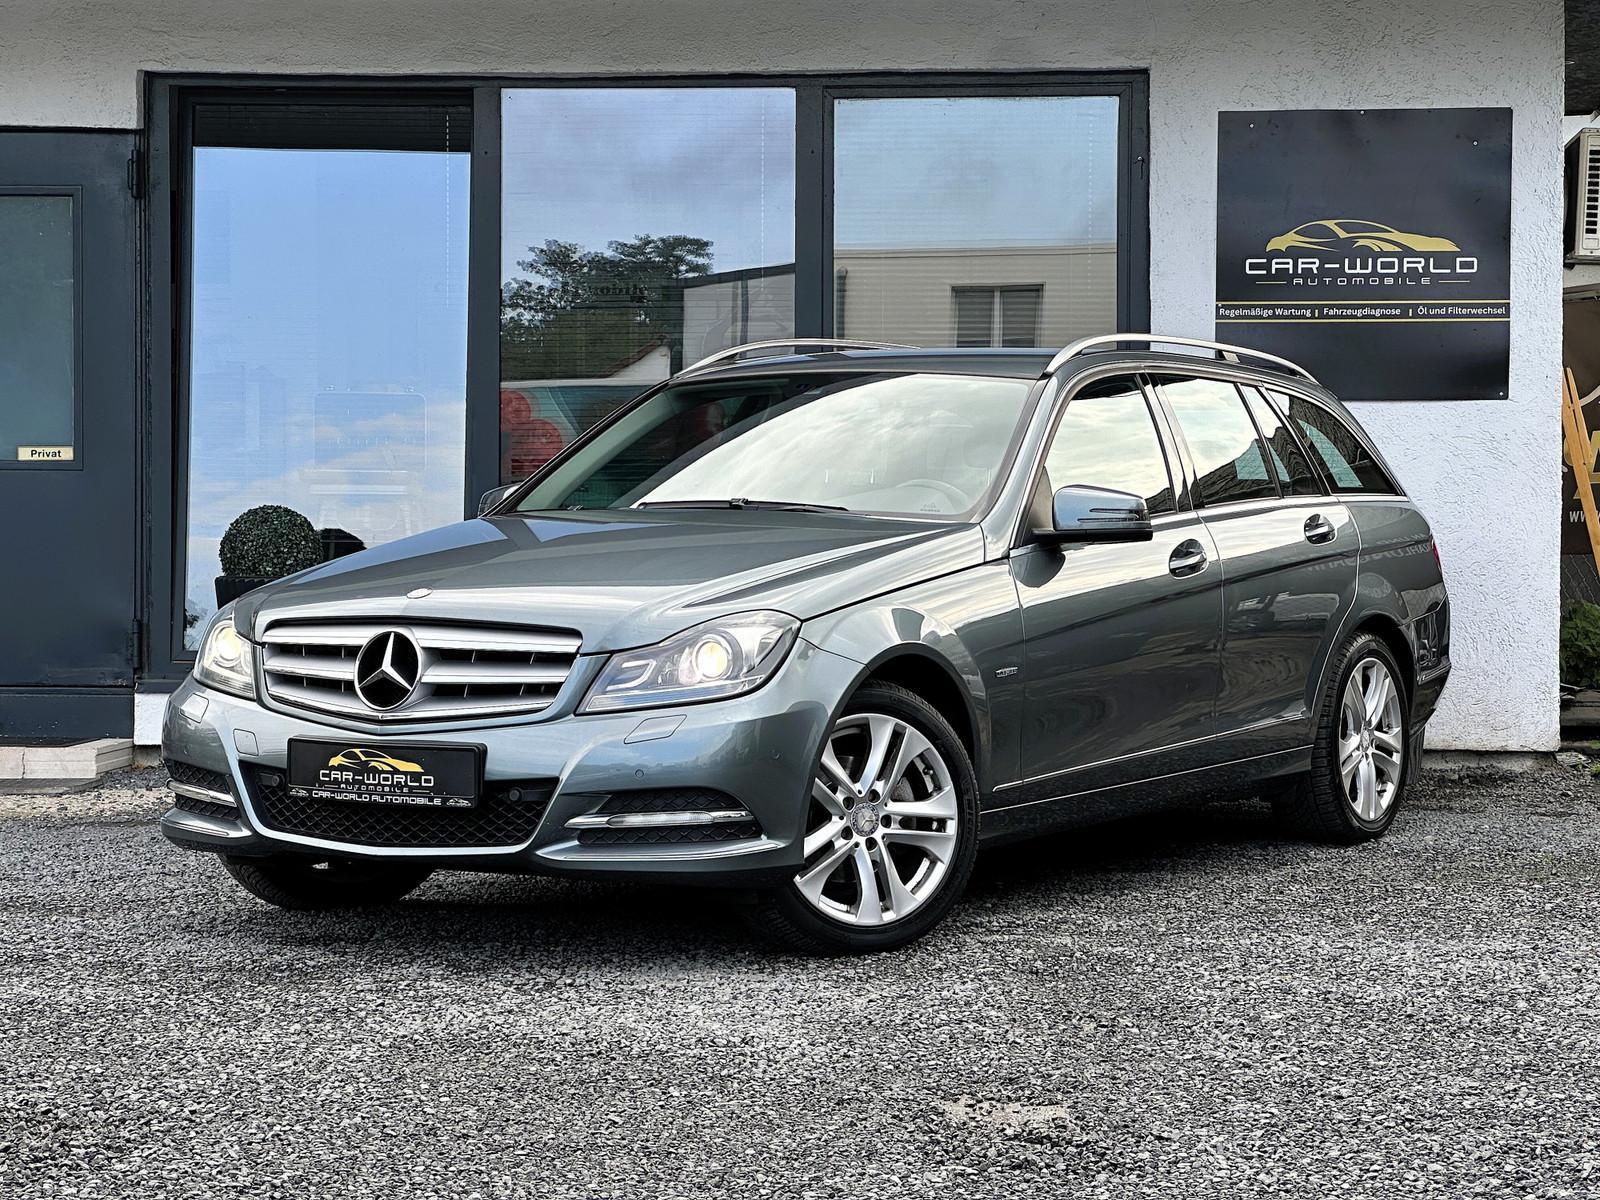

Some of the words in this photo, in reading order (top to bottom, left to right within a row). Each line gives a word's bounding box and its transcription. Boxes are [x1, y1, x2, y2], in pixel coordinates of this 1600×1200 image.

[1245, 257, 1478, 275] CAR-WORLD
[1293, 277, 1431, 286] AUTOMOBILE
[1219, 306, 1274, 317] Regelmäßige
[1274, 306, 1312, 317] Wartung
[1323, 306, 1401, 316] Fahrzeugdiagnose
[1417, 305, 1428, 315] Öl
[1430, 306, 1446, 315] und
[1448, 305, 1506, 315] Filterwechsel
[30, 449, 62, 458] Privat
[319, 770, 435, 787] CAR-WORLD
[340, 785, 409, 793] AUTOMOBILE
[312, 790, 370, 801] CAR-WORLD
[371, 794, 442, 806] AUTOMOBILE
